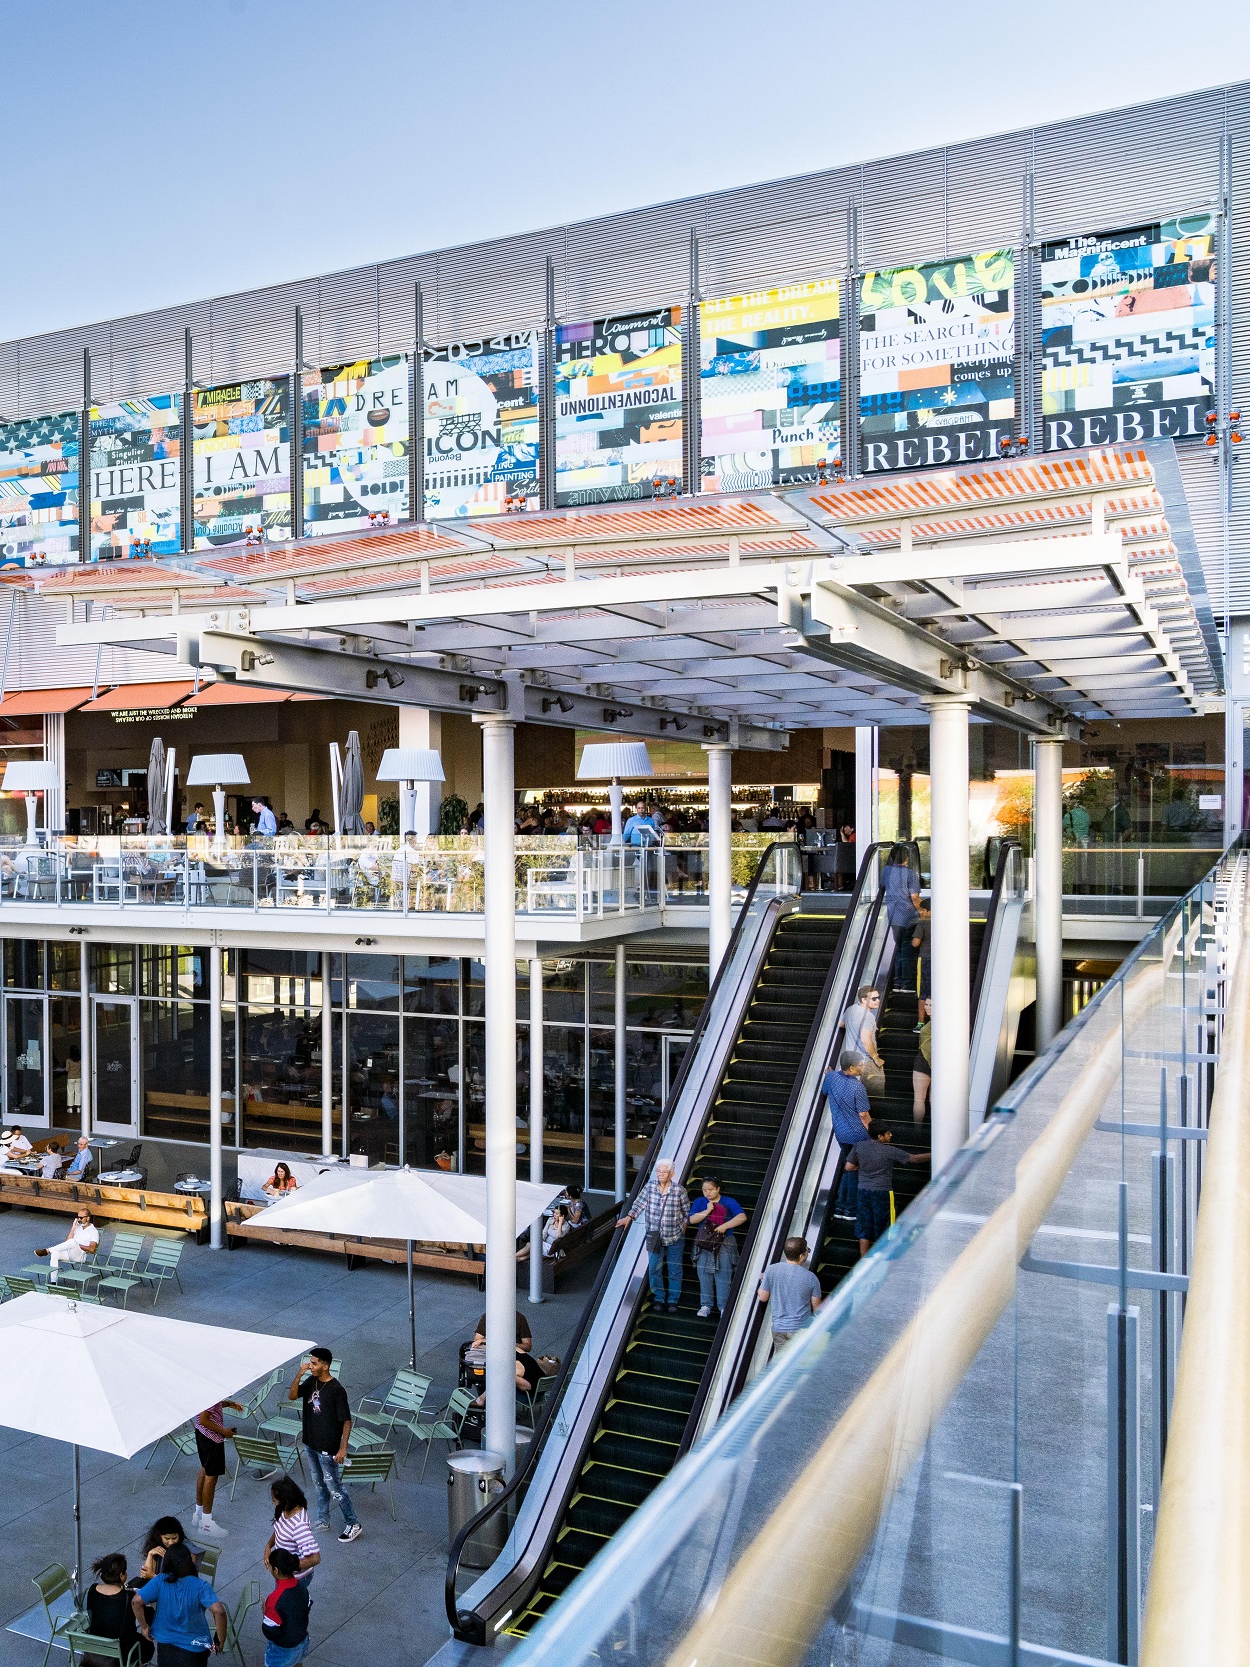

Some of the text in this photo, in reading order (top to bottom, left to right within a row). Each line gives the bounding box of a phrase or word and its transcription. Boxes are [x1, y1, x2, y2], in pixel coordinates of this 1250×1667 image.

[1054, 235, 1147, 261] Magnificent
[1067, 236, 1098, 250] The
[861, 250, 1015, 307] LOVE
[705, 280, 839, 314] SEE THE DREAM
[705, 305, 815, 333] THE REALITY.
[861, 322, 975, 350] THE SEARCH
[862, 338, 1014, 372] FOR SOMETHING
[954, 367, 1012, 382] comes up
[91, 428, 115, 436] MYTH
[427, 428, 502, 456] ICON
[772, 428, 814, 444] Punch
[111, 448, 145, 459] Singulier
[205, 447, 282, 483] I AM
[429, 453, 462, 464] Beyond
[94, 462, 176, 498] HERE
[361, 480, 405, 496] BOLD!
[495, 471, 534, 481] PAINTING
